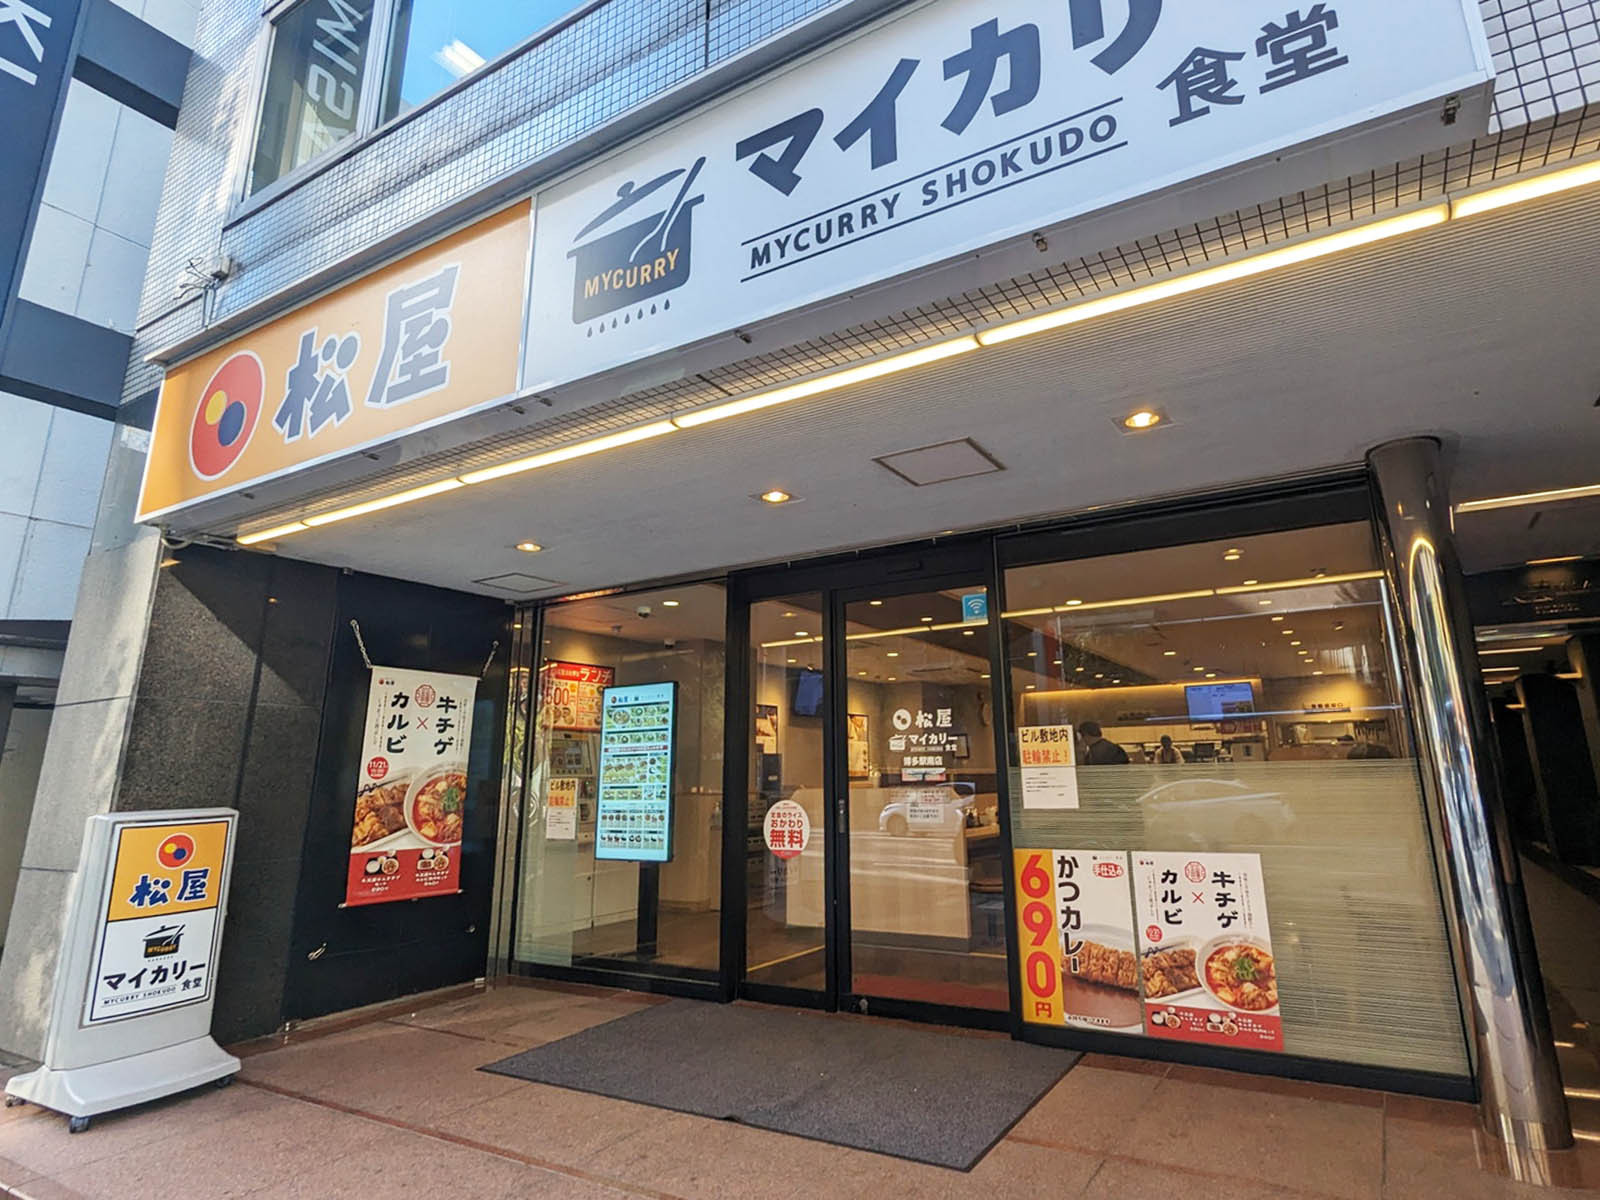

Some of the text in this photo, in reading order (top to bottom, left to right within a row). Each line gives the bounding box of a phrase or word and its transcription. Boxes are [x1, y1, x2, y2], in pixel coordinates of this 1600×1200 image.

[1157, 4, 1349, 127] 食堂
[750, 114, 1117, 270] MYCURRY SHOKUDO
[584, 249, 679, 299] MYCURRY
[272, 262, 462, 444] 松屋
[387, 692, 410, 753] カルビ
[434, 696, 458, 755] 牛チゲ
[909, 733, 958, 745] マイカリー
[915, 708, 953, 728] 松屋
[1021, 728, 1068, 743] ビル敷地内
[770, 829, 804, 848] 無料
[771, 819, 803, 828] おかわり
[129, 868, 210, 908] 松屋
[1057, 855, 1084, 973] かつカレー
[1161, 869, 1183, 926] カルビ
[1211, 871, 1239, 929] 牛チゲ
[103, 960, 206, 991] マイカリー
